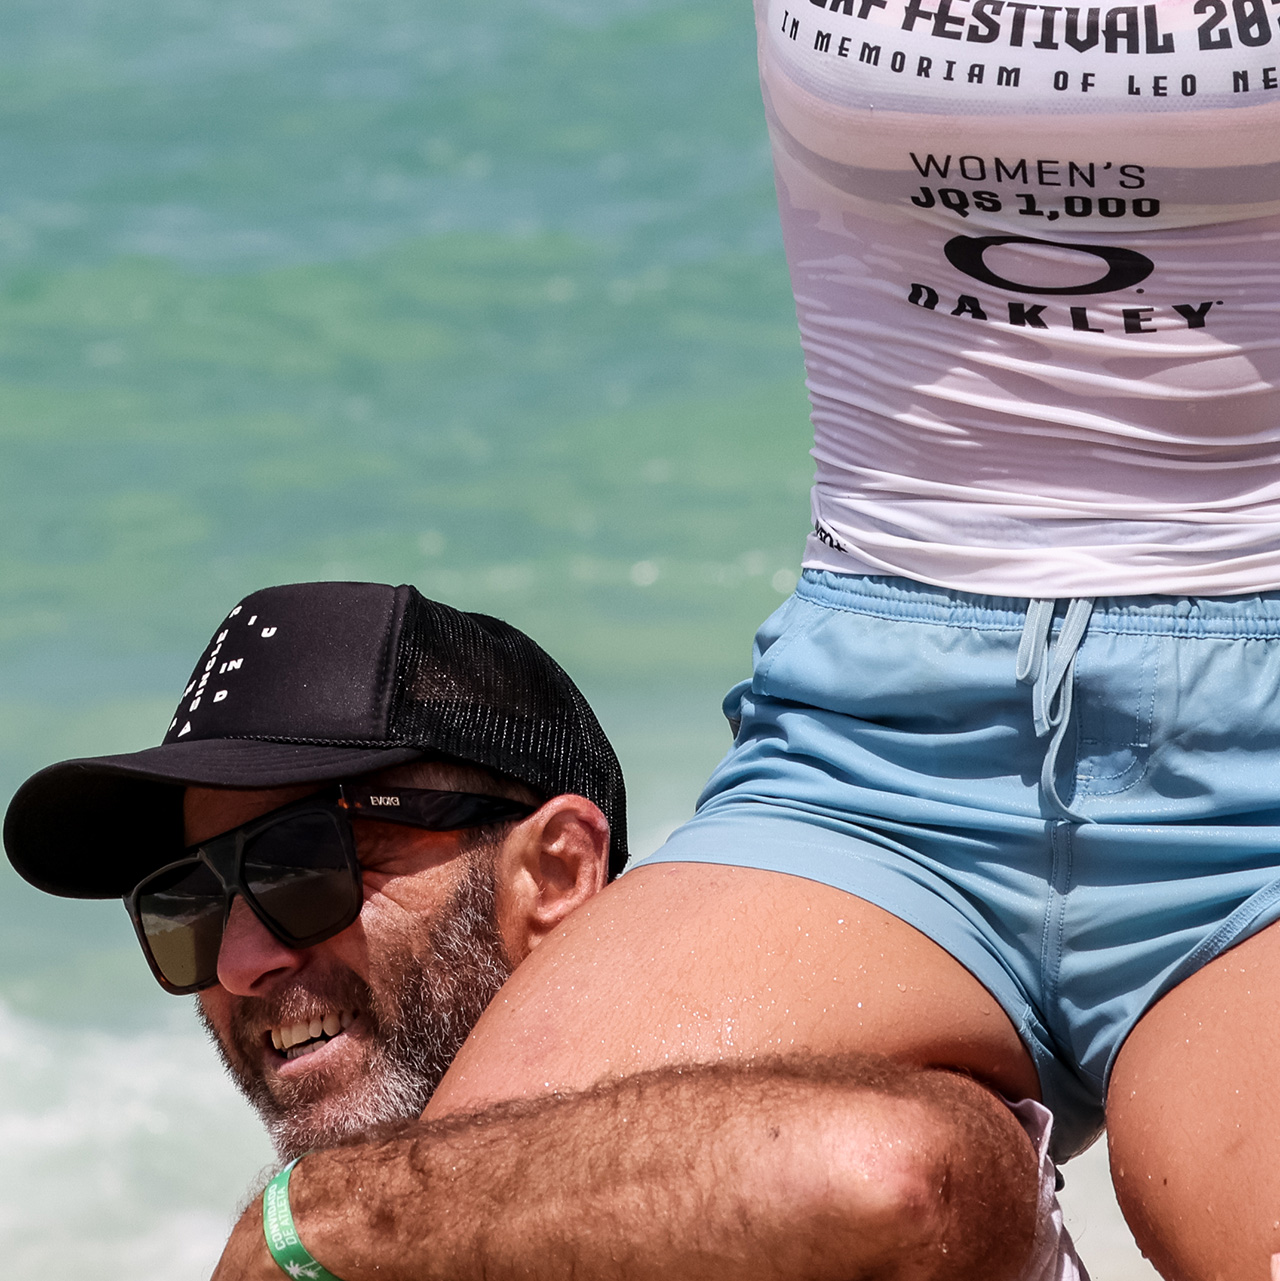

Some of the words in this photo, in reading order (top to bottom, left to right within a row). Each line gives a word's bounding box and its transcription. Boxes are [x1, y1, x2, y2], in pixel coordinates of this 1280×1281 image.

[781, 9, 800, 41] IN
[814, 30, 1021, 87] MEMORIAM
[1053, 70, 1096, 92] OF
[1128, 74, 1197, 97] LEO
[909, 152, 1146, 189] WOMEN'S
[910, 186, 1002, 218] JQS
[1016, 193, 1161, 221] 1,000
[907, 282, 1214, 334] OAKLEY
[267, 1183, 286, 1251] CONVIDADO
[276, 1186, 291, 1227] ATLETA
[282, 1228, 298, 1246] DE
